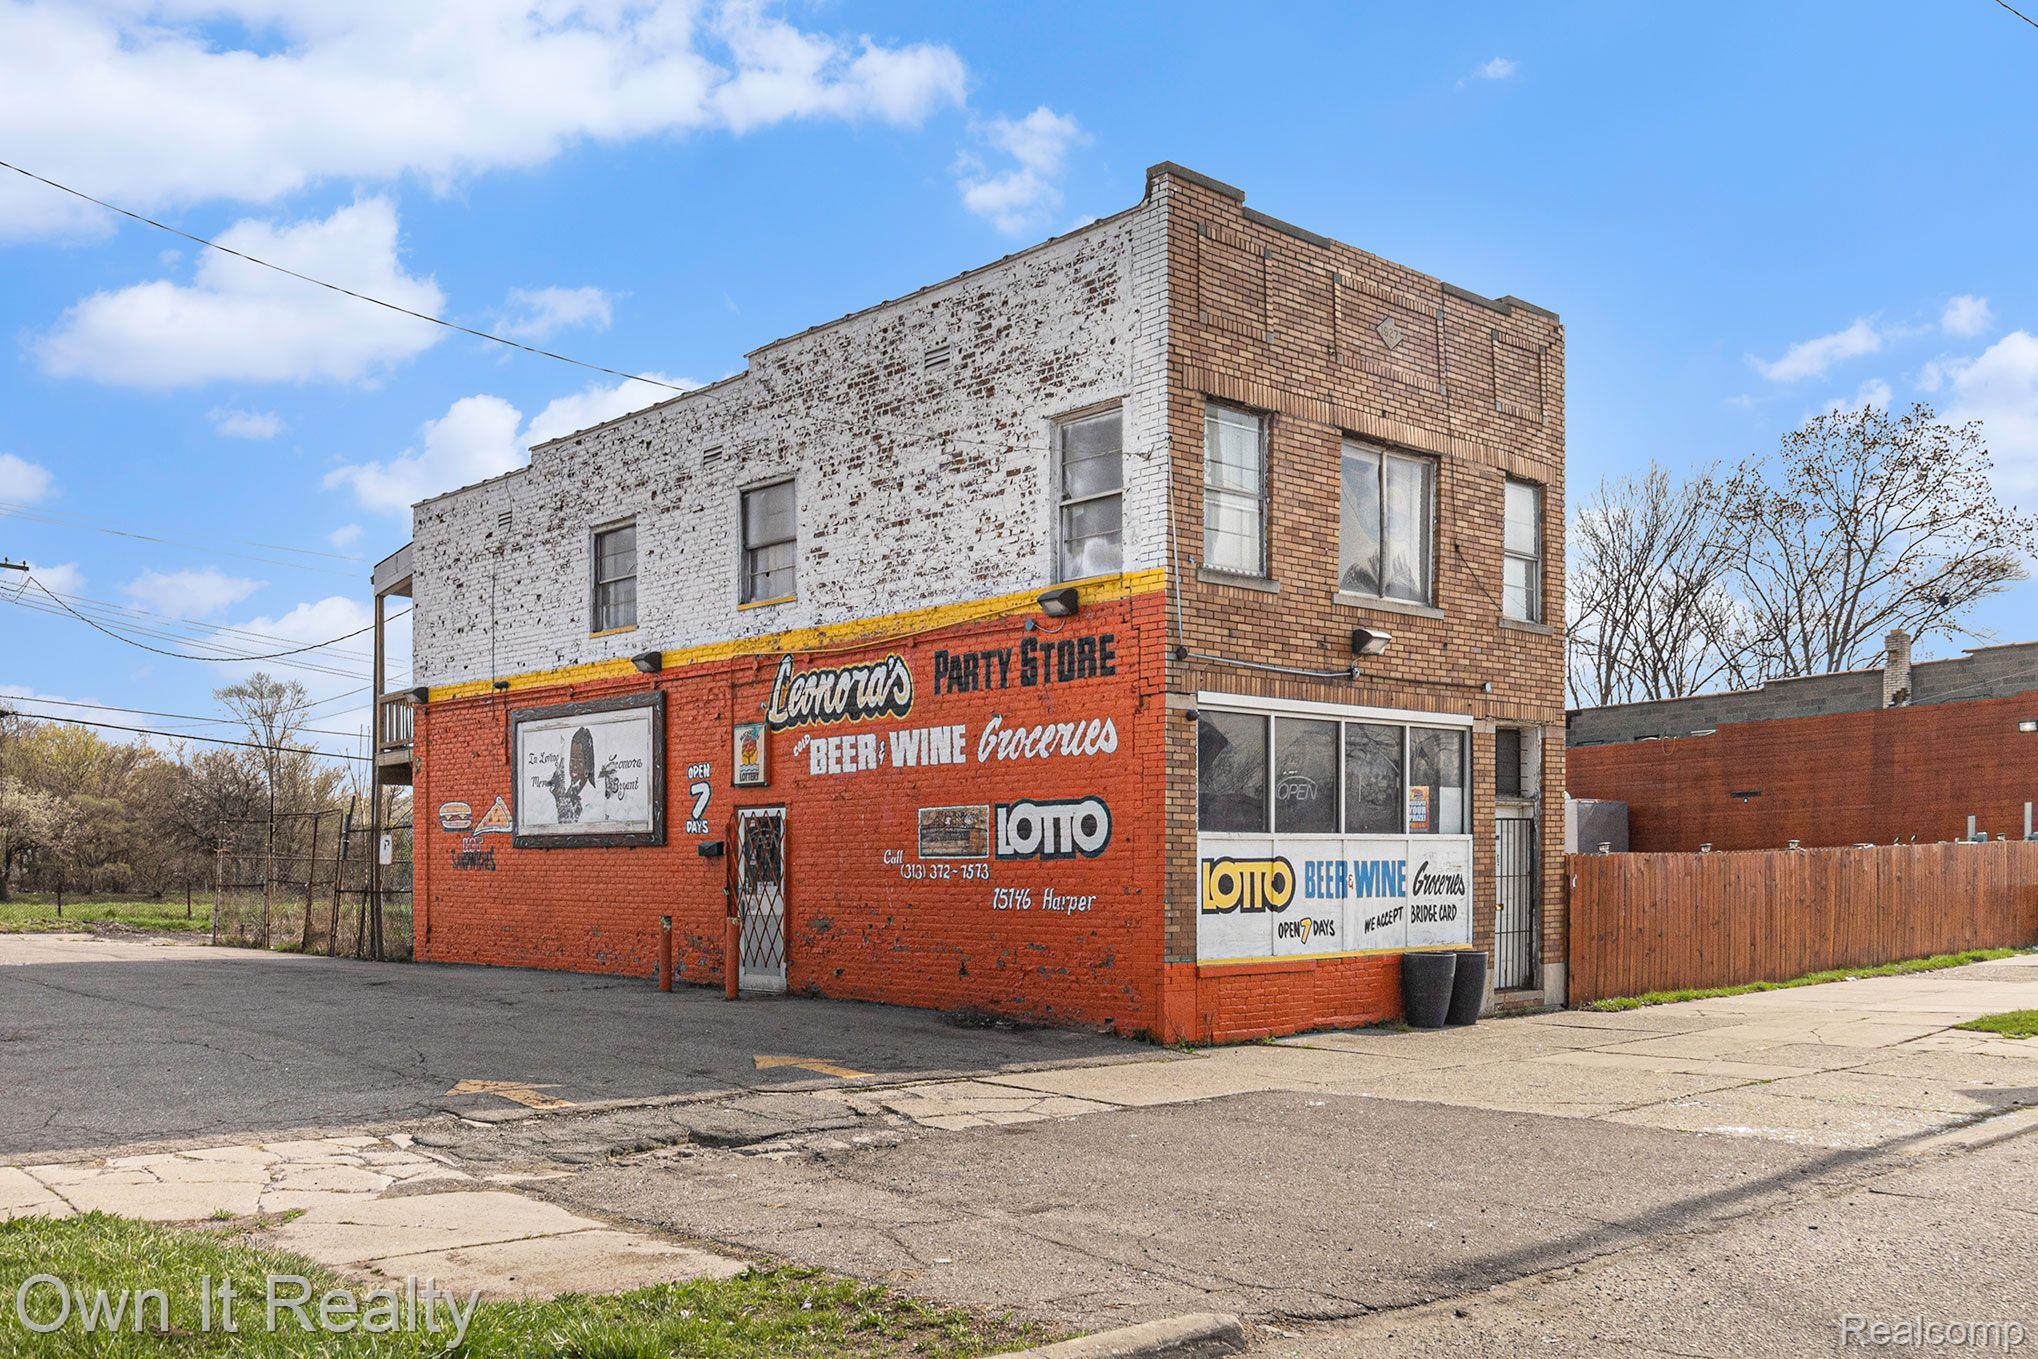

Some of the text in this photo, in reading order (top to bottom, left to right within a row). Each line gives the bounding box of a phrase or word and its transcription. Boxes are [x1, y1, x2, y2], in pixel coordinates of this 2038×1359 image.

[933, 633, 1117, 696] PARTY STORE
[766, 652, 914, 735] Leonora's
[809, 733, 877, 775] BEER
[888, 724, 967, 768] WINE
[976, 715, 1119, 764] Groceries
[687, 763, 711, 779] OPEN
[740, 772, 759, 781] LOTTERY
[690, 781, 711, 820] 7
[1278, 783, 1318, 801] OPEN
[686, 820, 709, 834] DAYS
[995, 796, 1113, 861] LOTTO
[883, 849, 904, 866] Call
[900, 864, 927, 880] (313)
[1201, 856, 1296, 915] LOTTO
[1305, 860, 1348, 899] BEER
[1354, 860, 1406, 898] WINE
[1412, 860, 1466, 897] Groceries
[1042, 889, 1098, 915] Harper
[1411, 904, 1458, 924] BRIDGE CARD
[1278, 917, 1336, 945] OPEN 7 DAYS
[1364, 906, 1404, 934] WE ACCEPT
